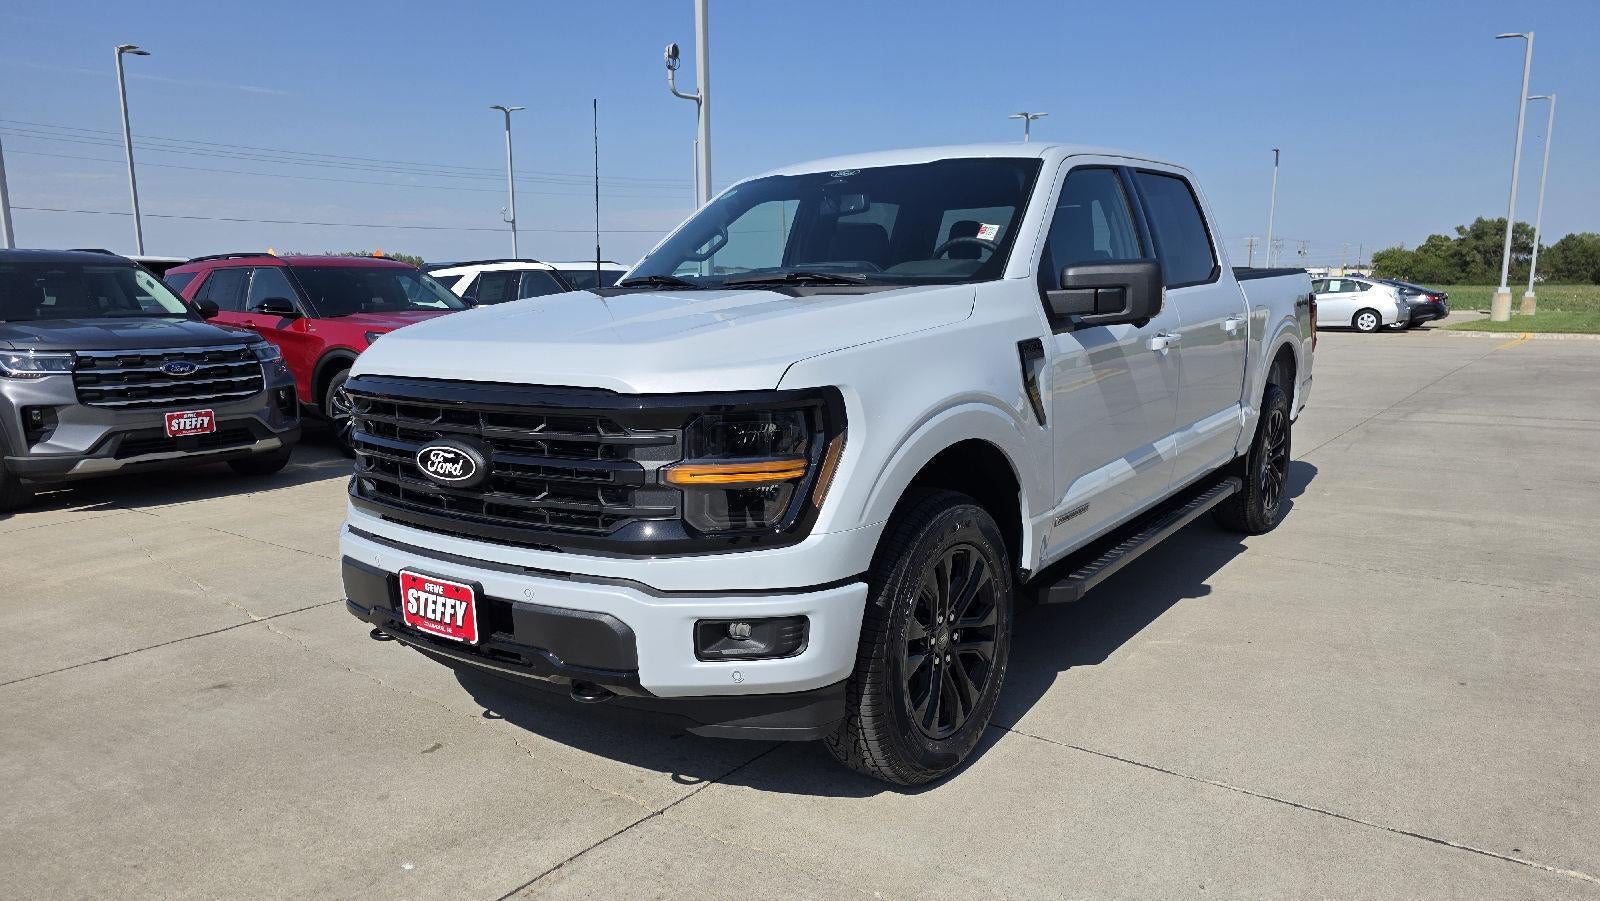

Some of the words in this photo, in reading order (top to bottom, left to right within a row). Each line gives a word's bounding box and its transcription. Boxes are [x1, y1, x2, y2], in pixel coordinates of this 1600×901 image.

[171, 417, 210, 431] STEFFY
[428, 450, 463, 476] Ford
[407, 588, 468, 627] STEFFY
